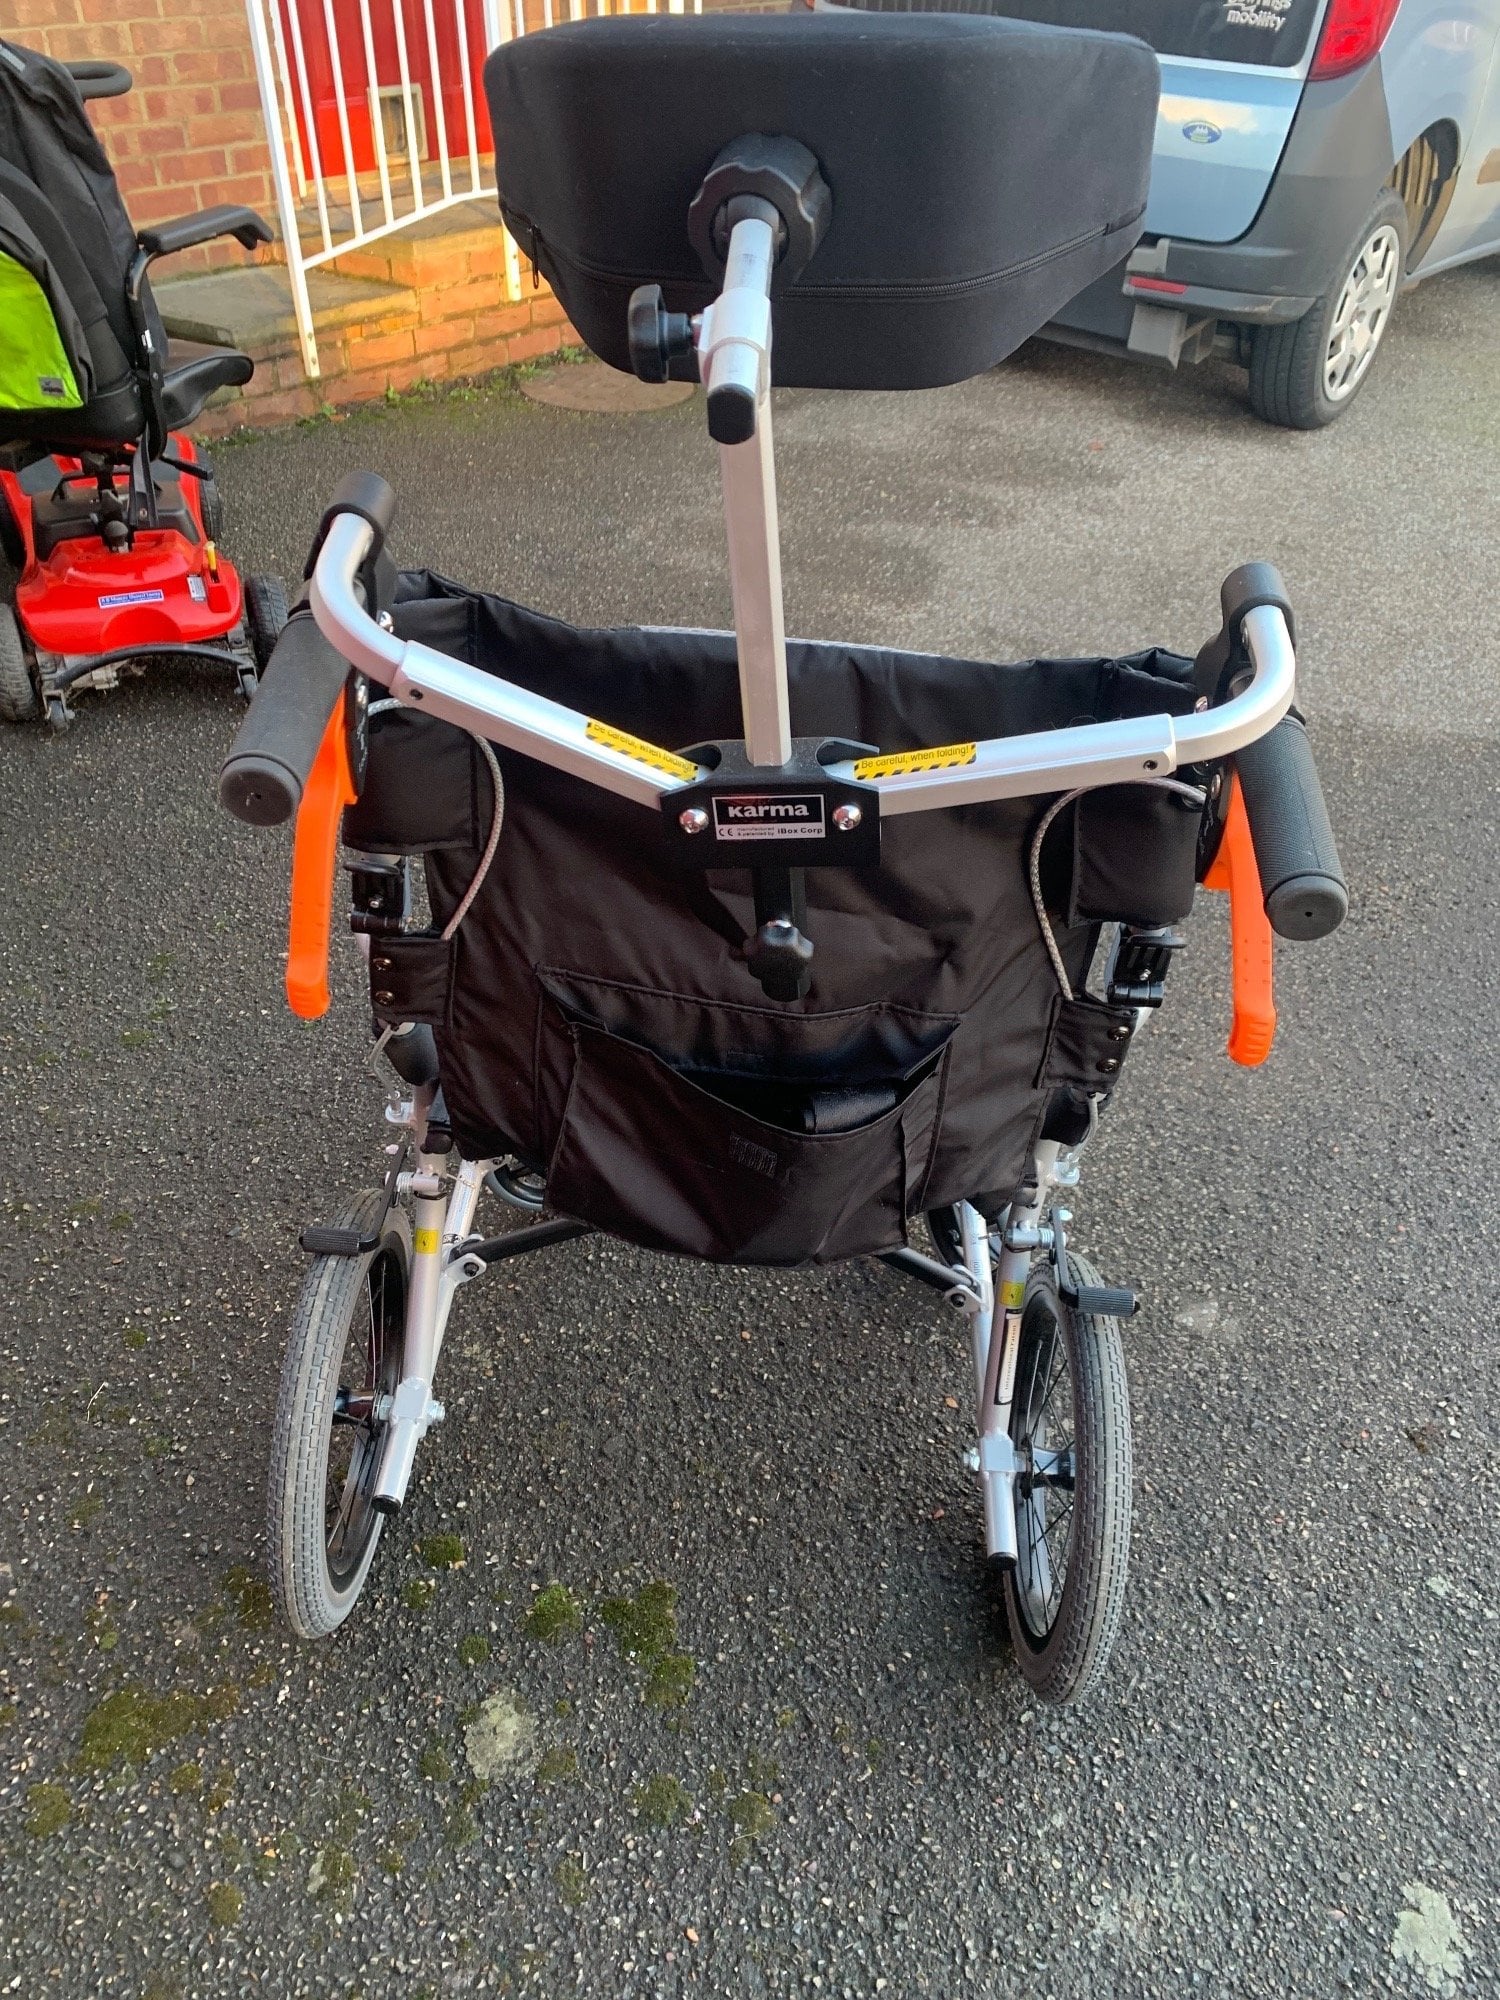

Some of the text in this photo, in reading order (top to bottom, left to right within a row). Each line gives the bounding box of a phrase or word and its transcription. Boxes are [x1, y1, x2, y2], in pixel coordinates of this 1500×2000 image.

[1227, 10, 1286, 33] mobility
[861, 745, 970, 769] Be careful, when folding!
[777, 827, 823, 835] iBox Corp
